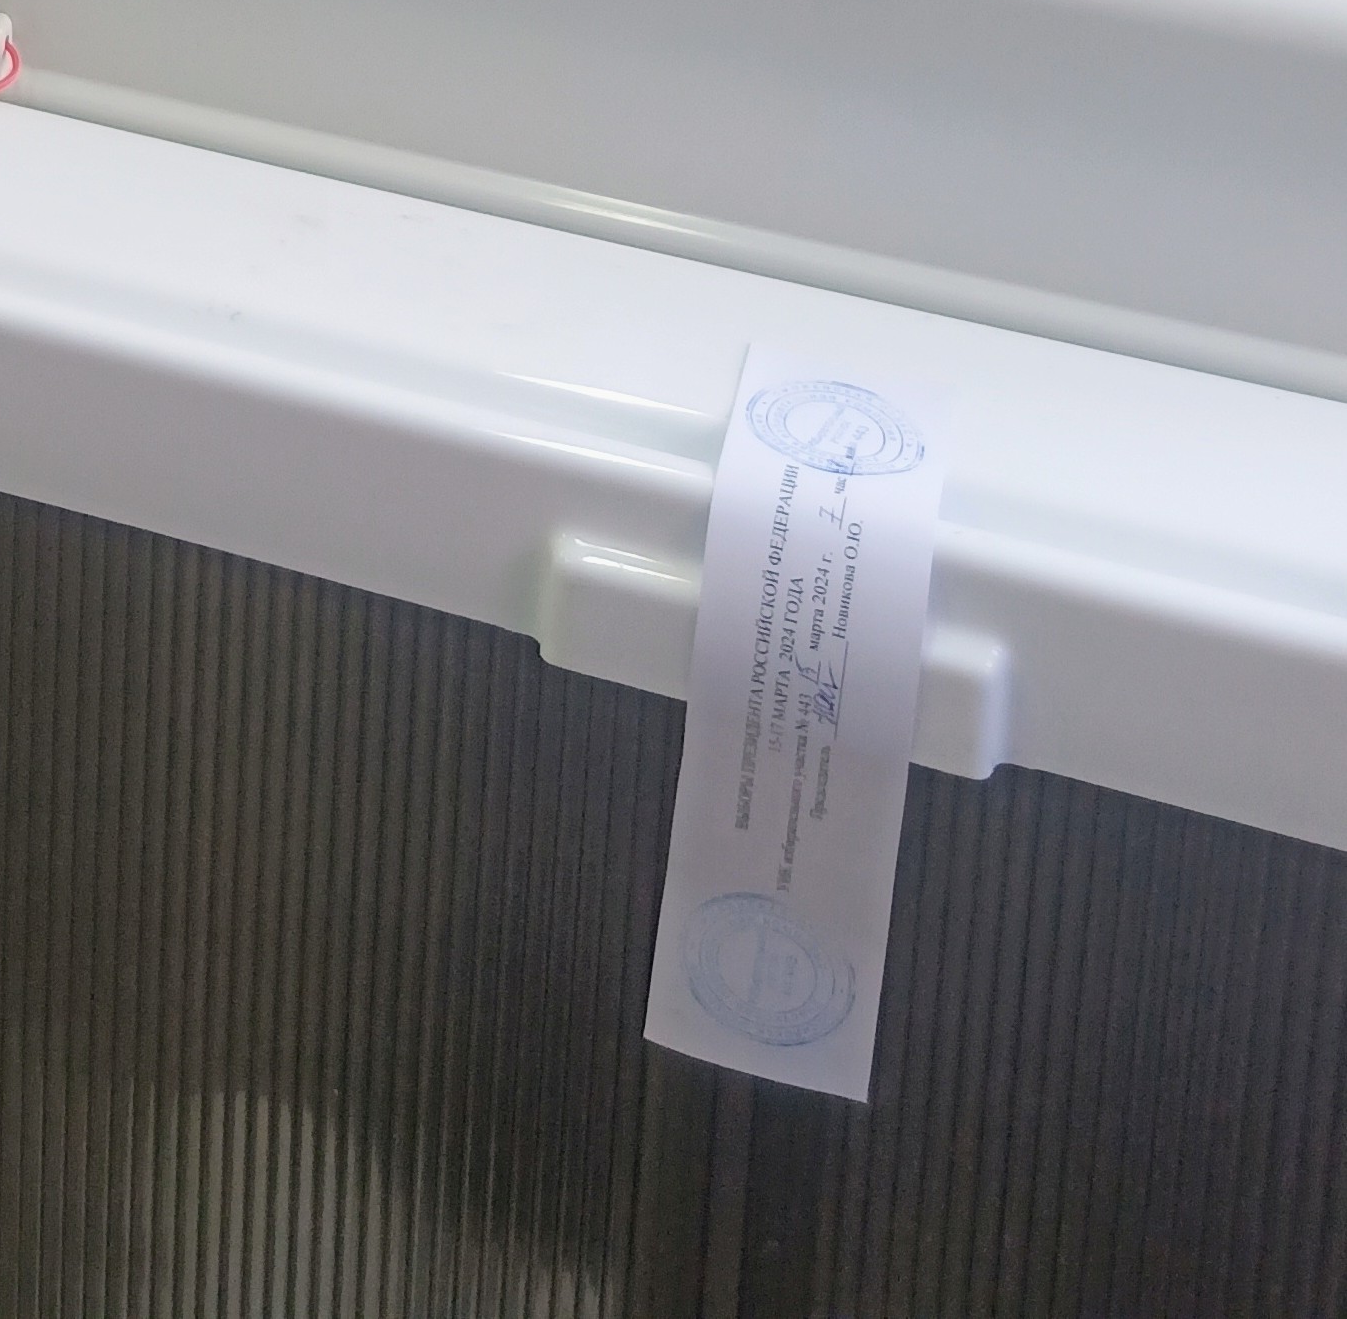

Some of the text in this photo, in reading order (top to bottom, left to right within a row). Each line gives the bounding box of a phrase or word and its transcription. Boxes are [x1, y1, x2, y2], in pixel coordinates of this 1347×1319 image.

[768, 464, 800, 566] ФЕДЕРАЦИИ
[821, 552, 833, 564] г.
[843, 520, 863, 560] О.Ю.
[784, 577, 803, 624] ГОДА
[811, 568, 830, 605] 2024
[831, 566, 856, 640] Новикова
[749, 569, 779, 685] РОССИЙСКОЙ
[779, 629, 796, 662] 2024
[809, 609, 826, 652] марта
[771, 670, 791, 721] МАРТА
[797, 694, 812, 716] 443
[740, 688, 764, 773] ПРЕЗИДЕНТА
